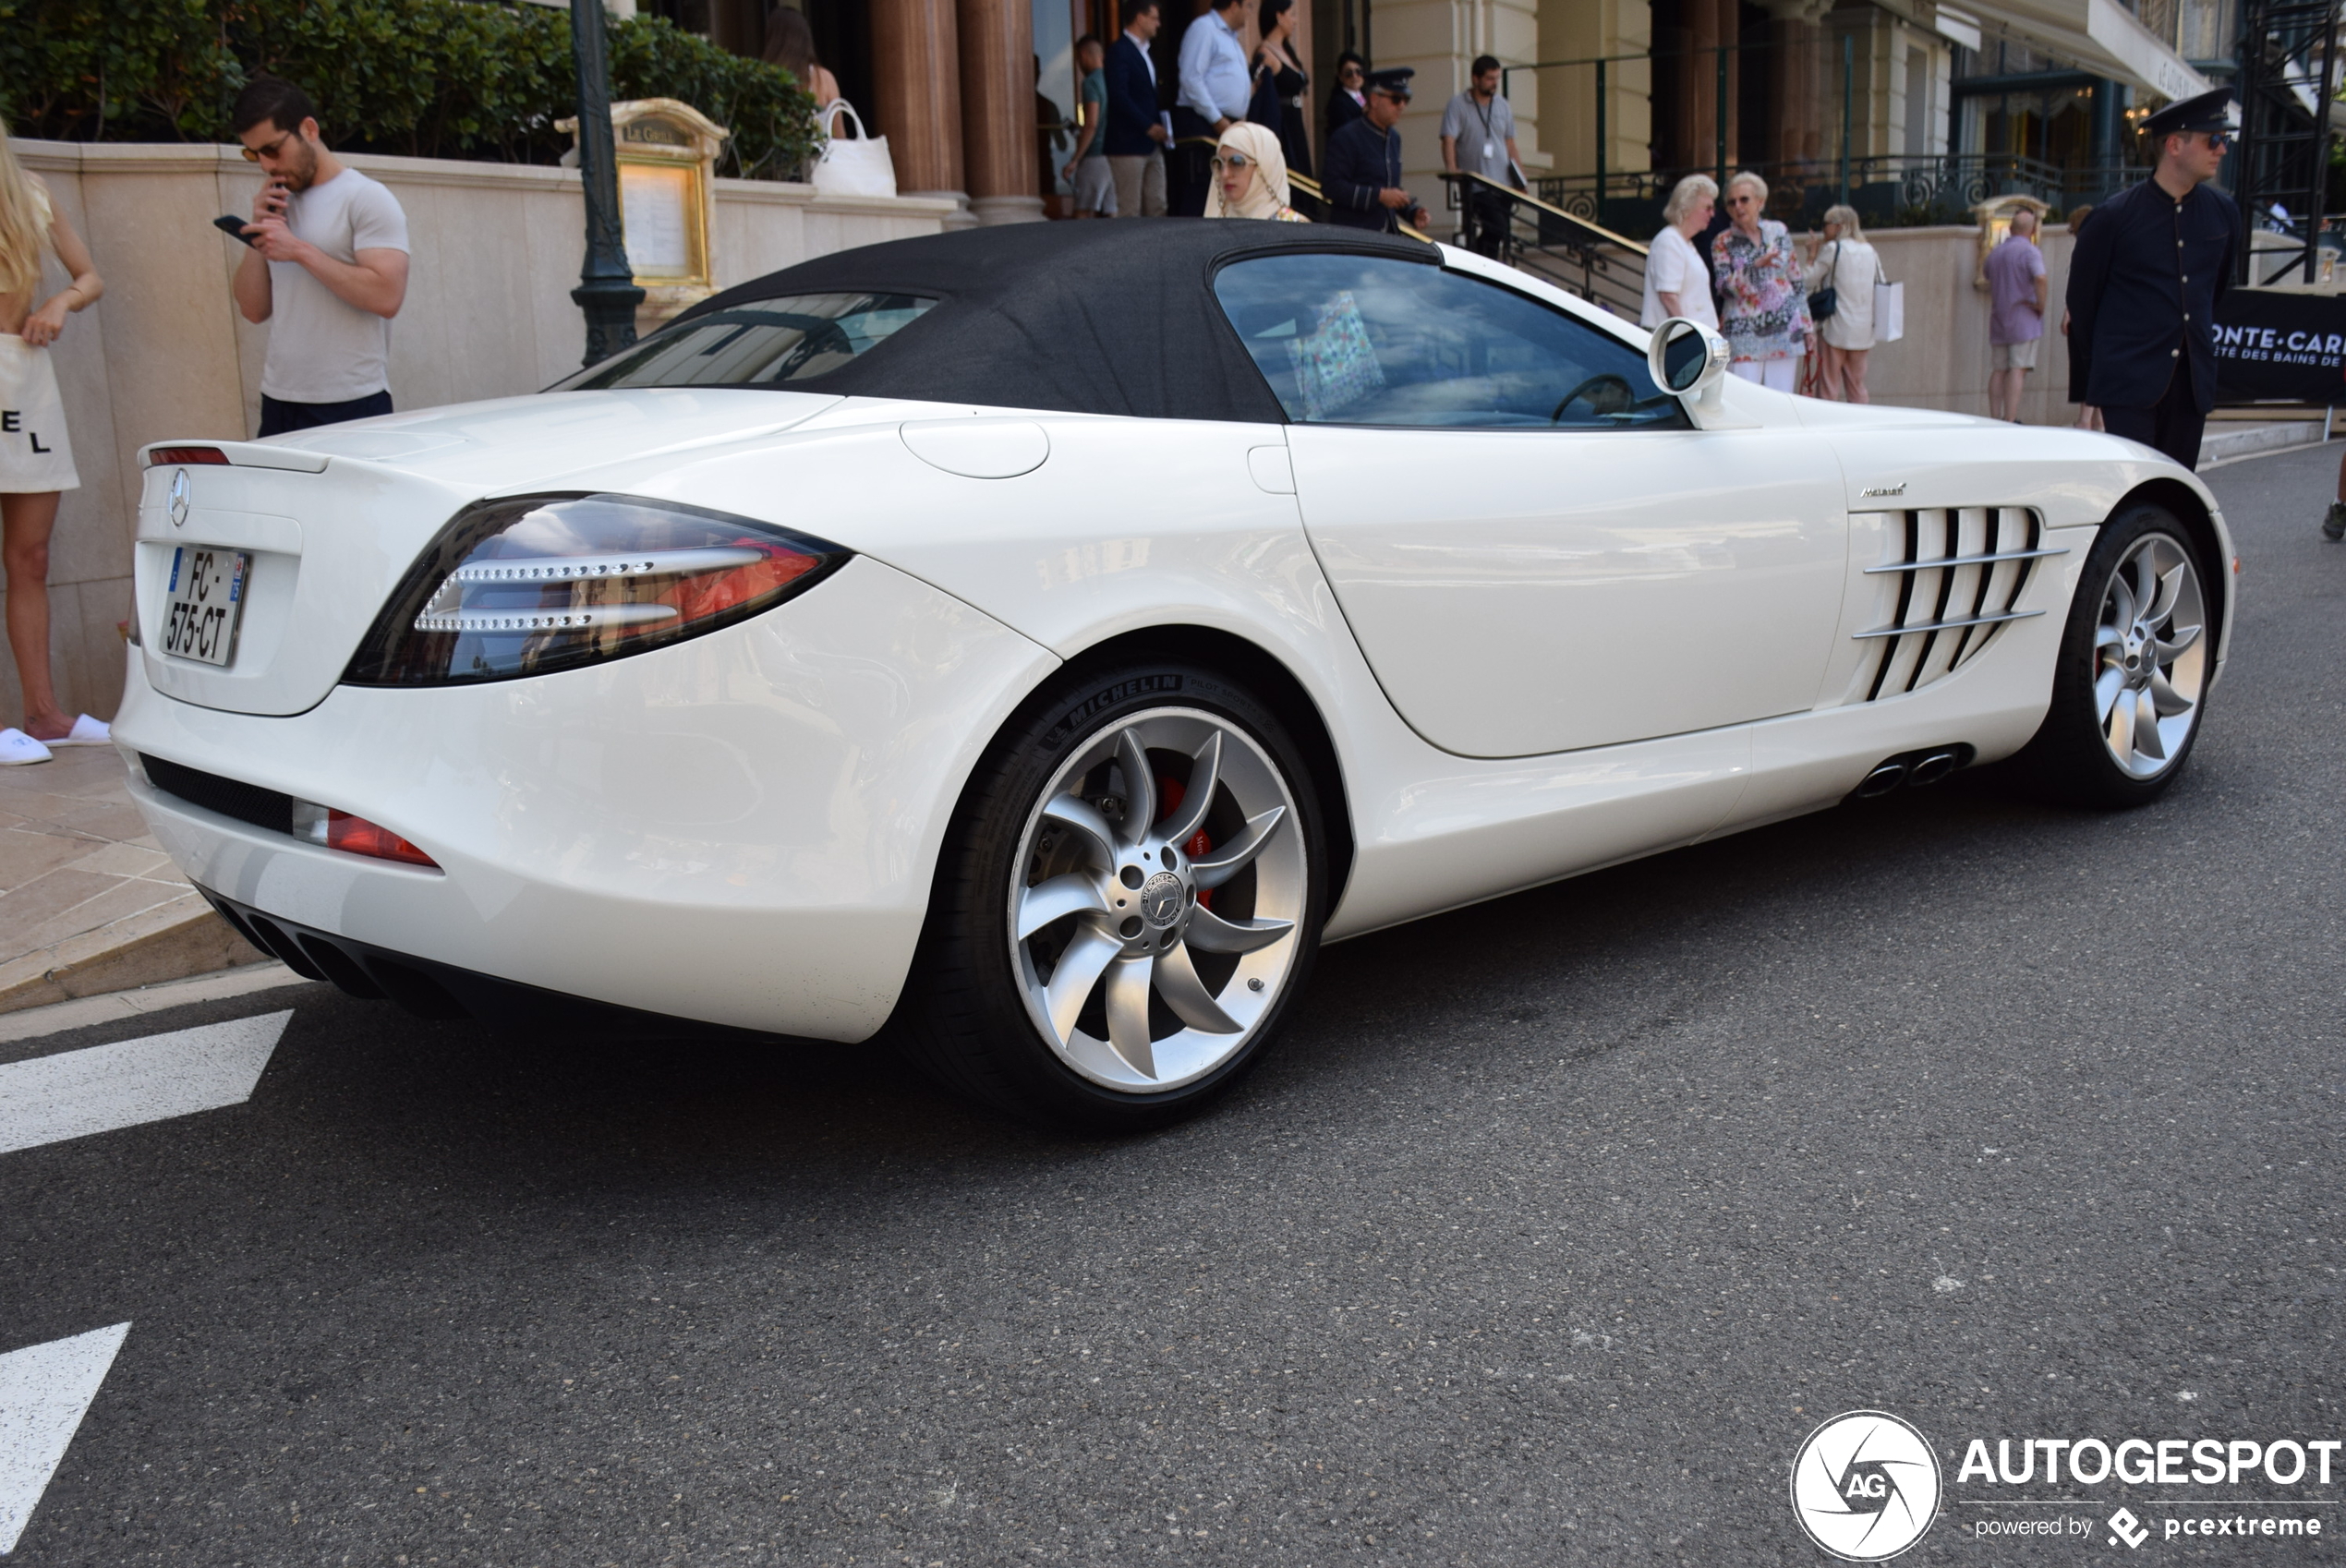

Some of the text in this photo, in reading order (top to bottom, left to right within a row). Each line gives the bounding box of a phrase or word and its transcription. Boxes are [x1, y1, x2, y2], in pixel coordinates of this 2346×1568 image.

[2241, 348, 2268, 361] DES
[2273, 351, 2316, 366] BAINS
[2320, 355, 2341, 368] DE
[167, 602, 226, 659] 575-CT
[1069, 675, 1177, 727] MICHELIN
[1190, 678, 1219, 691] PILOT
